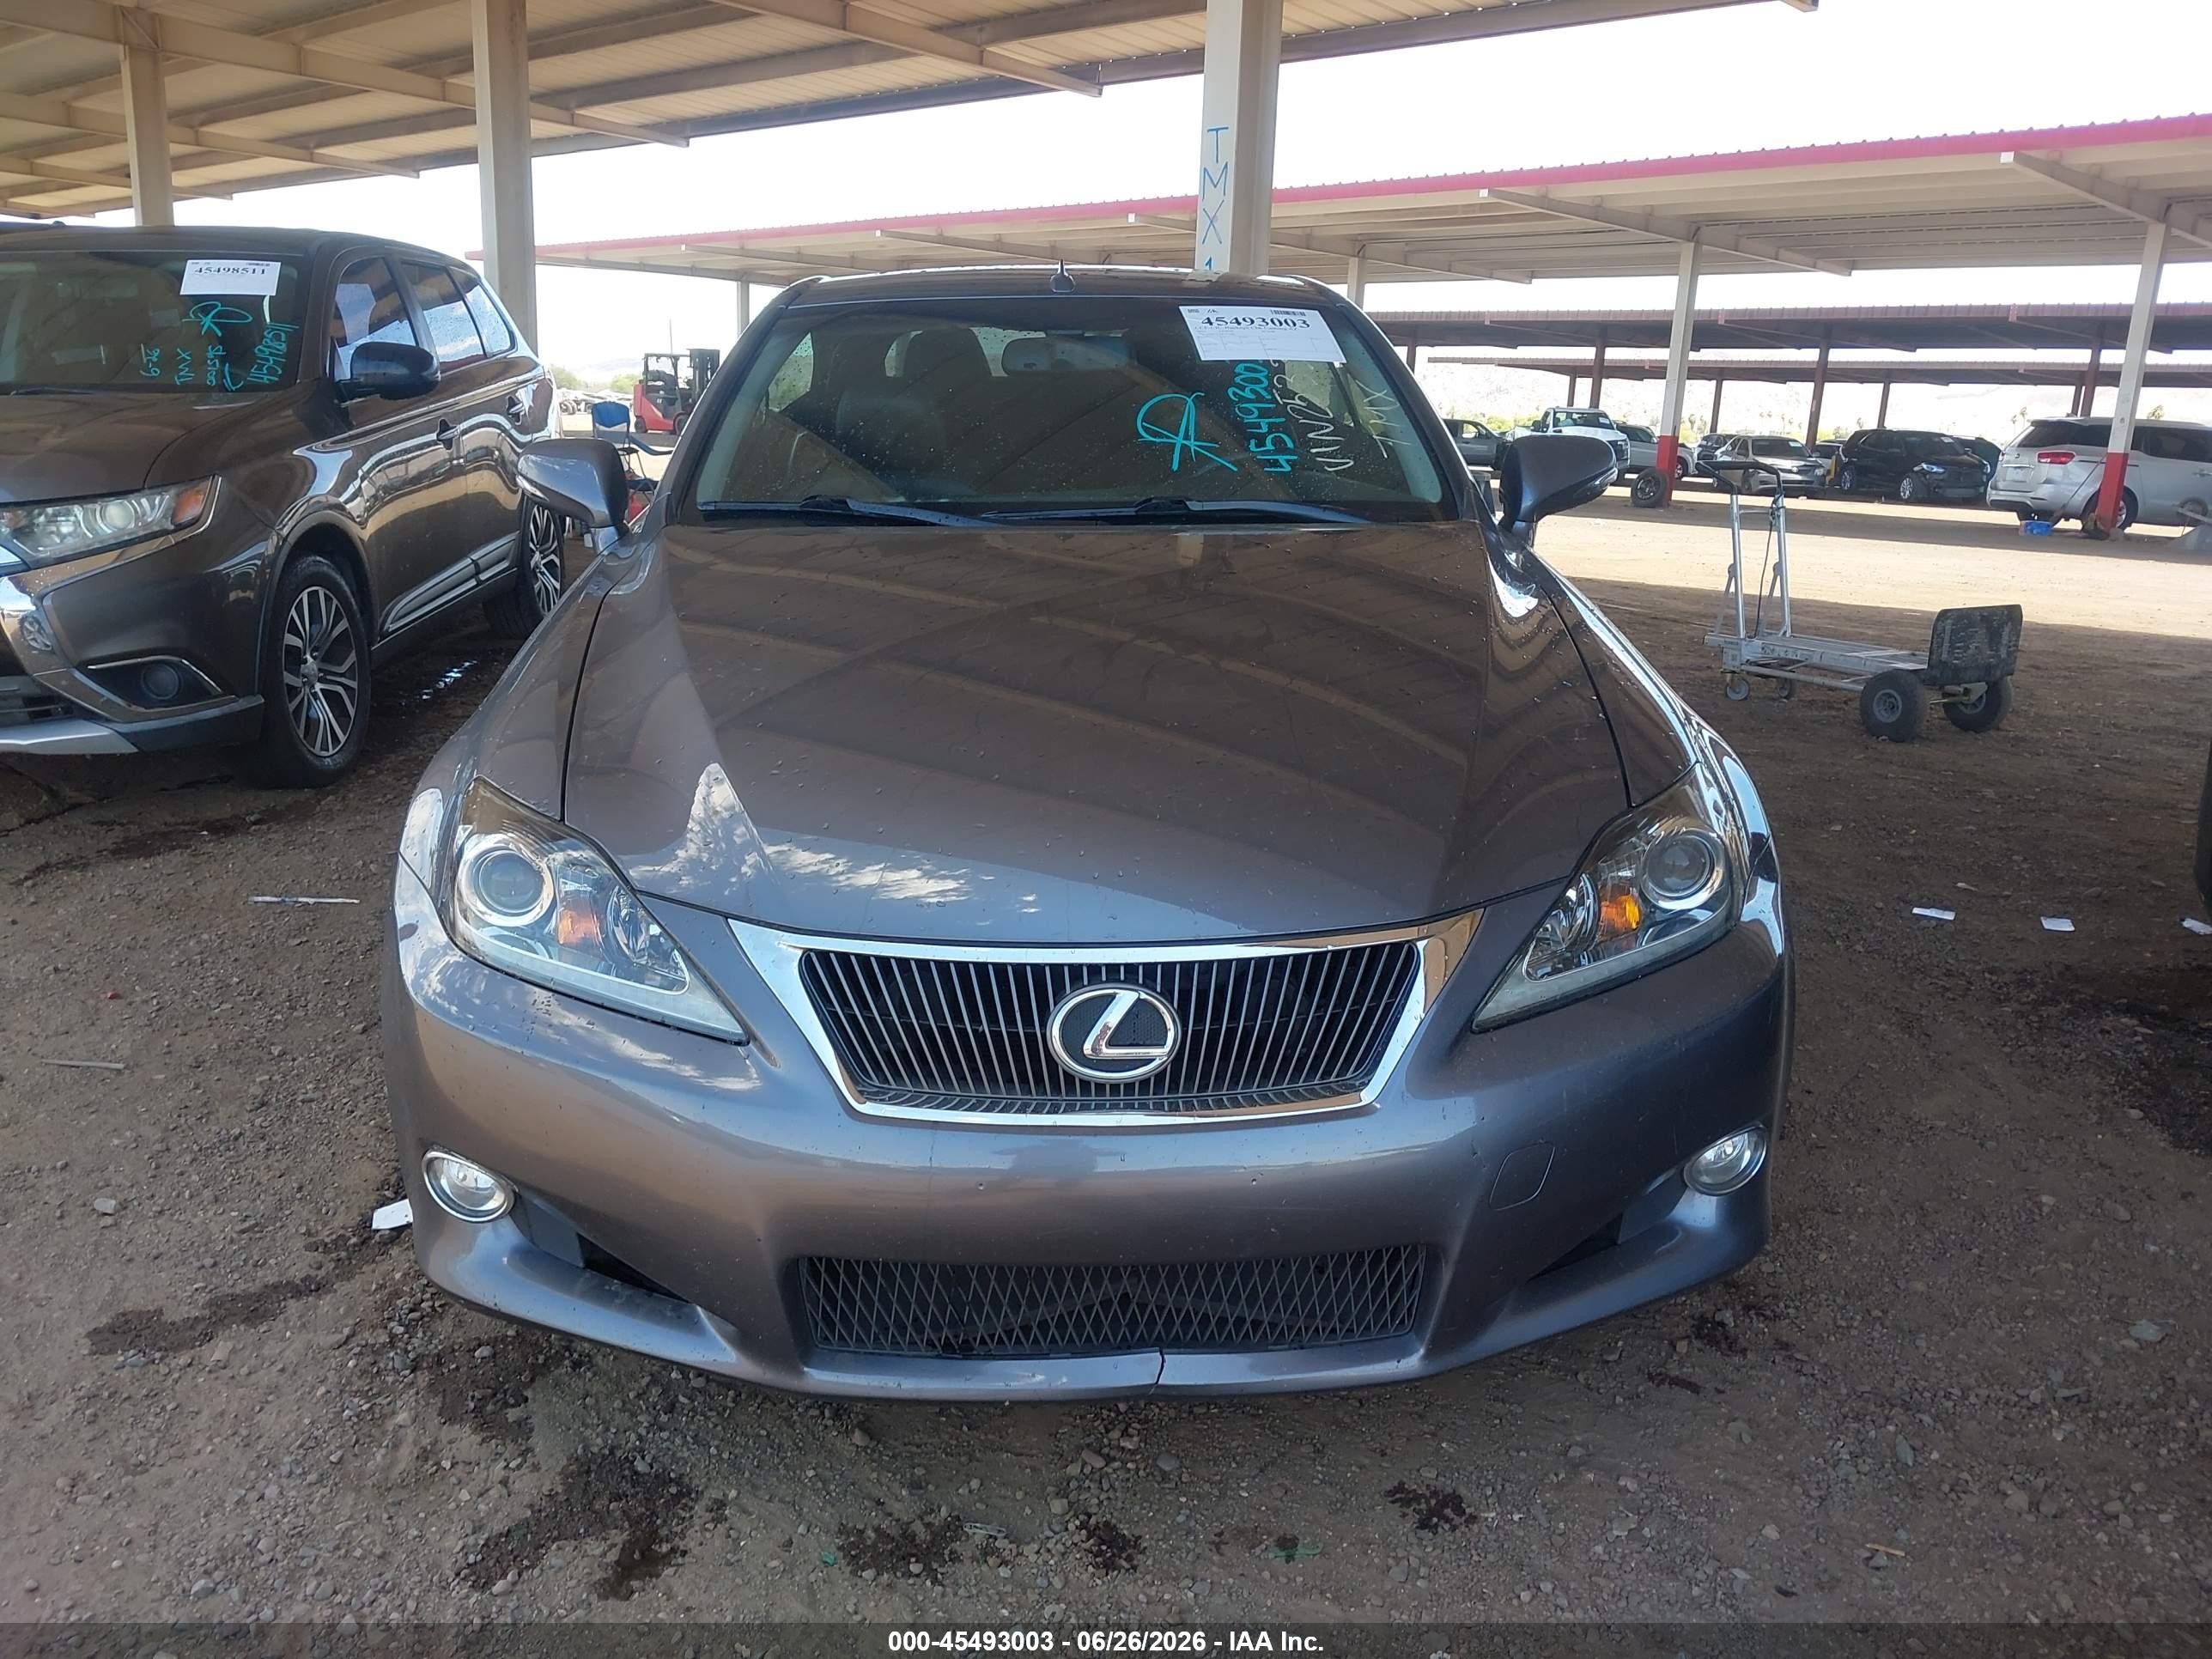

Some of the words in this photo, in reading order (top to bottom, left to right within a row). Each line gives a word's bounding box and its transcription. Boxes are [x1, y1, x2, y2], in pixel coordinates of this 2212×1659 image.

[1202, 126, 1229, 245] TMX
[194, 266, 267, 275] 45498511
[247, 322, 300, 384] 45498511
[1201, 316, 1310, 329] 45493003
[1227, 361, 1298, 471] 4549300
